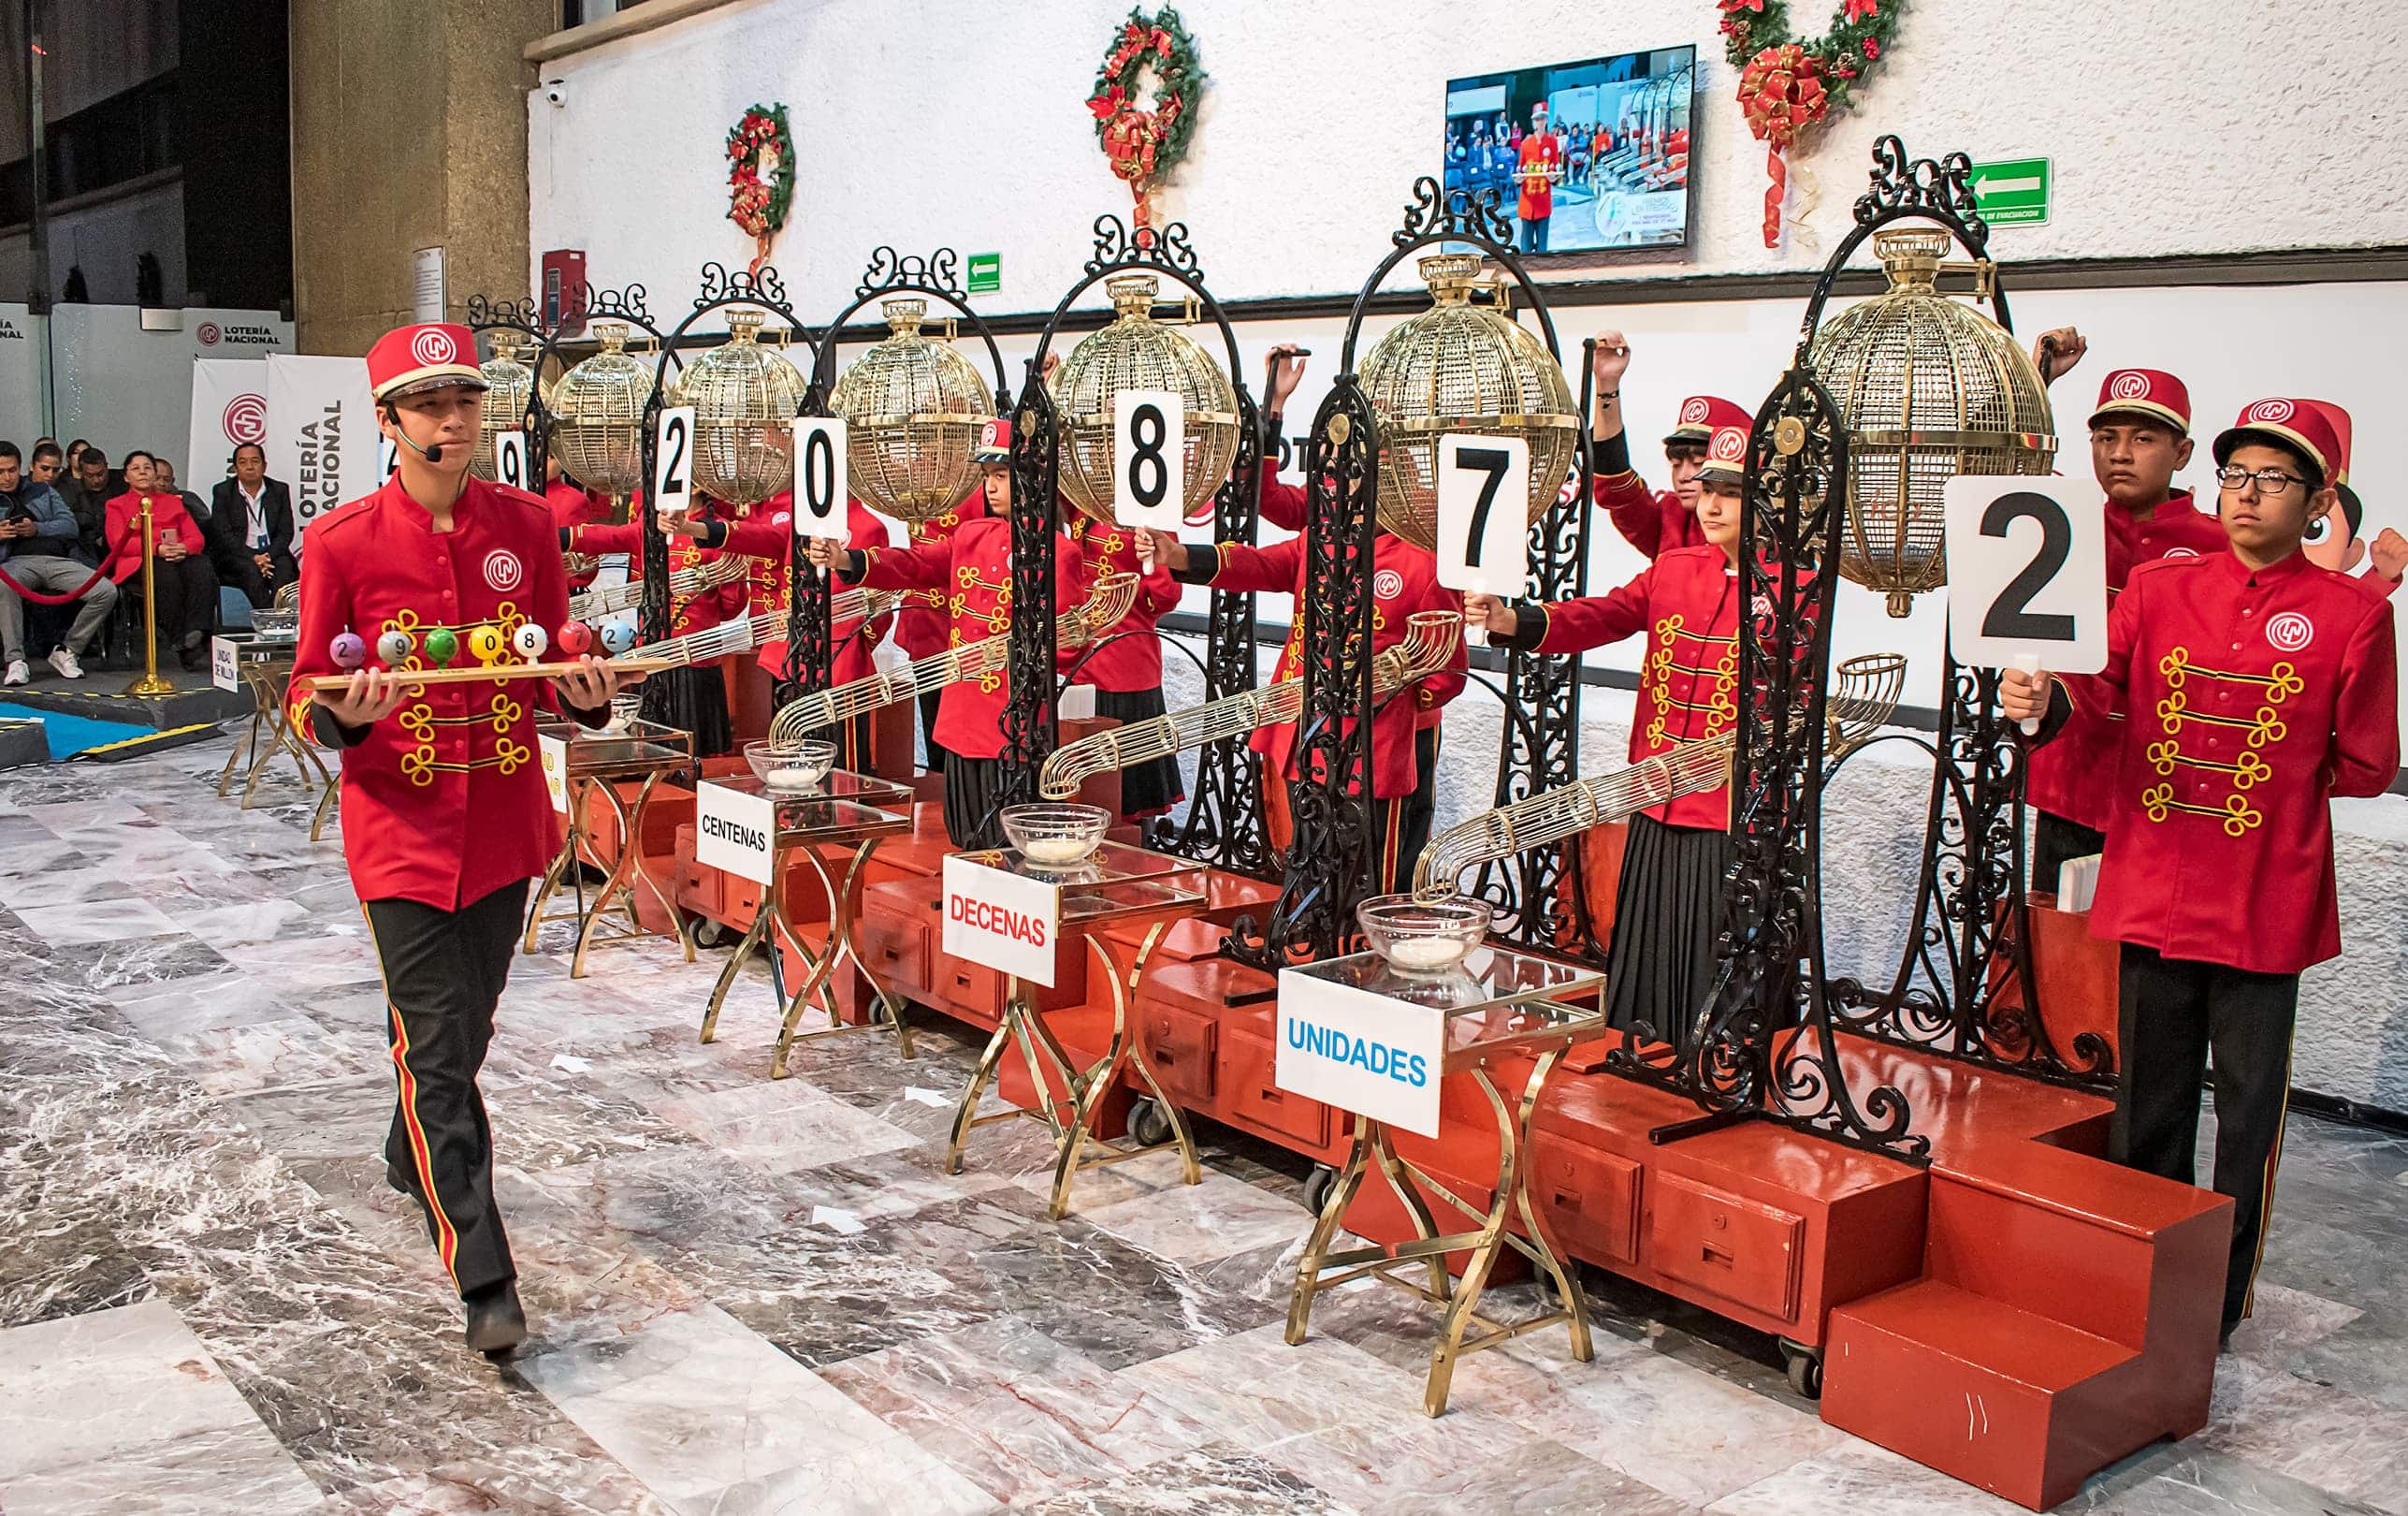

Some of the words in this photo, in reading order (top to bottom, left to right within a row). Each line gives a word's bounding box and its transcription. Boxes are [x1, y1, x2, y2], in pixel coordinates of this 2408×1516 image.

[225, 326, 271, 335] LOTERÍA
[225, 336, 281, 344] NACIONAL
[297, 421, 319, 532] OTERÍA
[322, 400, 341, 512] ACIONAL
[503, 440, 520, 487] 9
[662, 416, 686, 494] 2
[805, 428, 834, 517] 0
[1129, 403, 1168, 507] 8
[1456, 447, 1510, 567] 7
[1979, 491, 2076, 642] 2
[337, 642, 348, 658] 2
[395, 639, 406, 655] 9
[485, 635, 496, 651] 0
[524, 633, 535, 649] 8
[576, 631, 586, 646] 7
[605, 629, 617, 644] 2
[703, 813, 765, 853] CENTENAS
[950, 894, 1045, 947] DECENAS
[1288, 1017, 1427, 1087] UNIDADES
